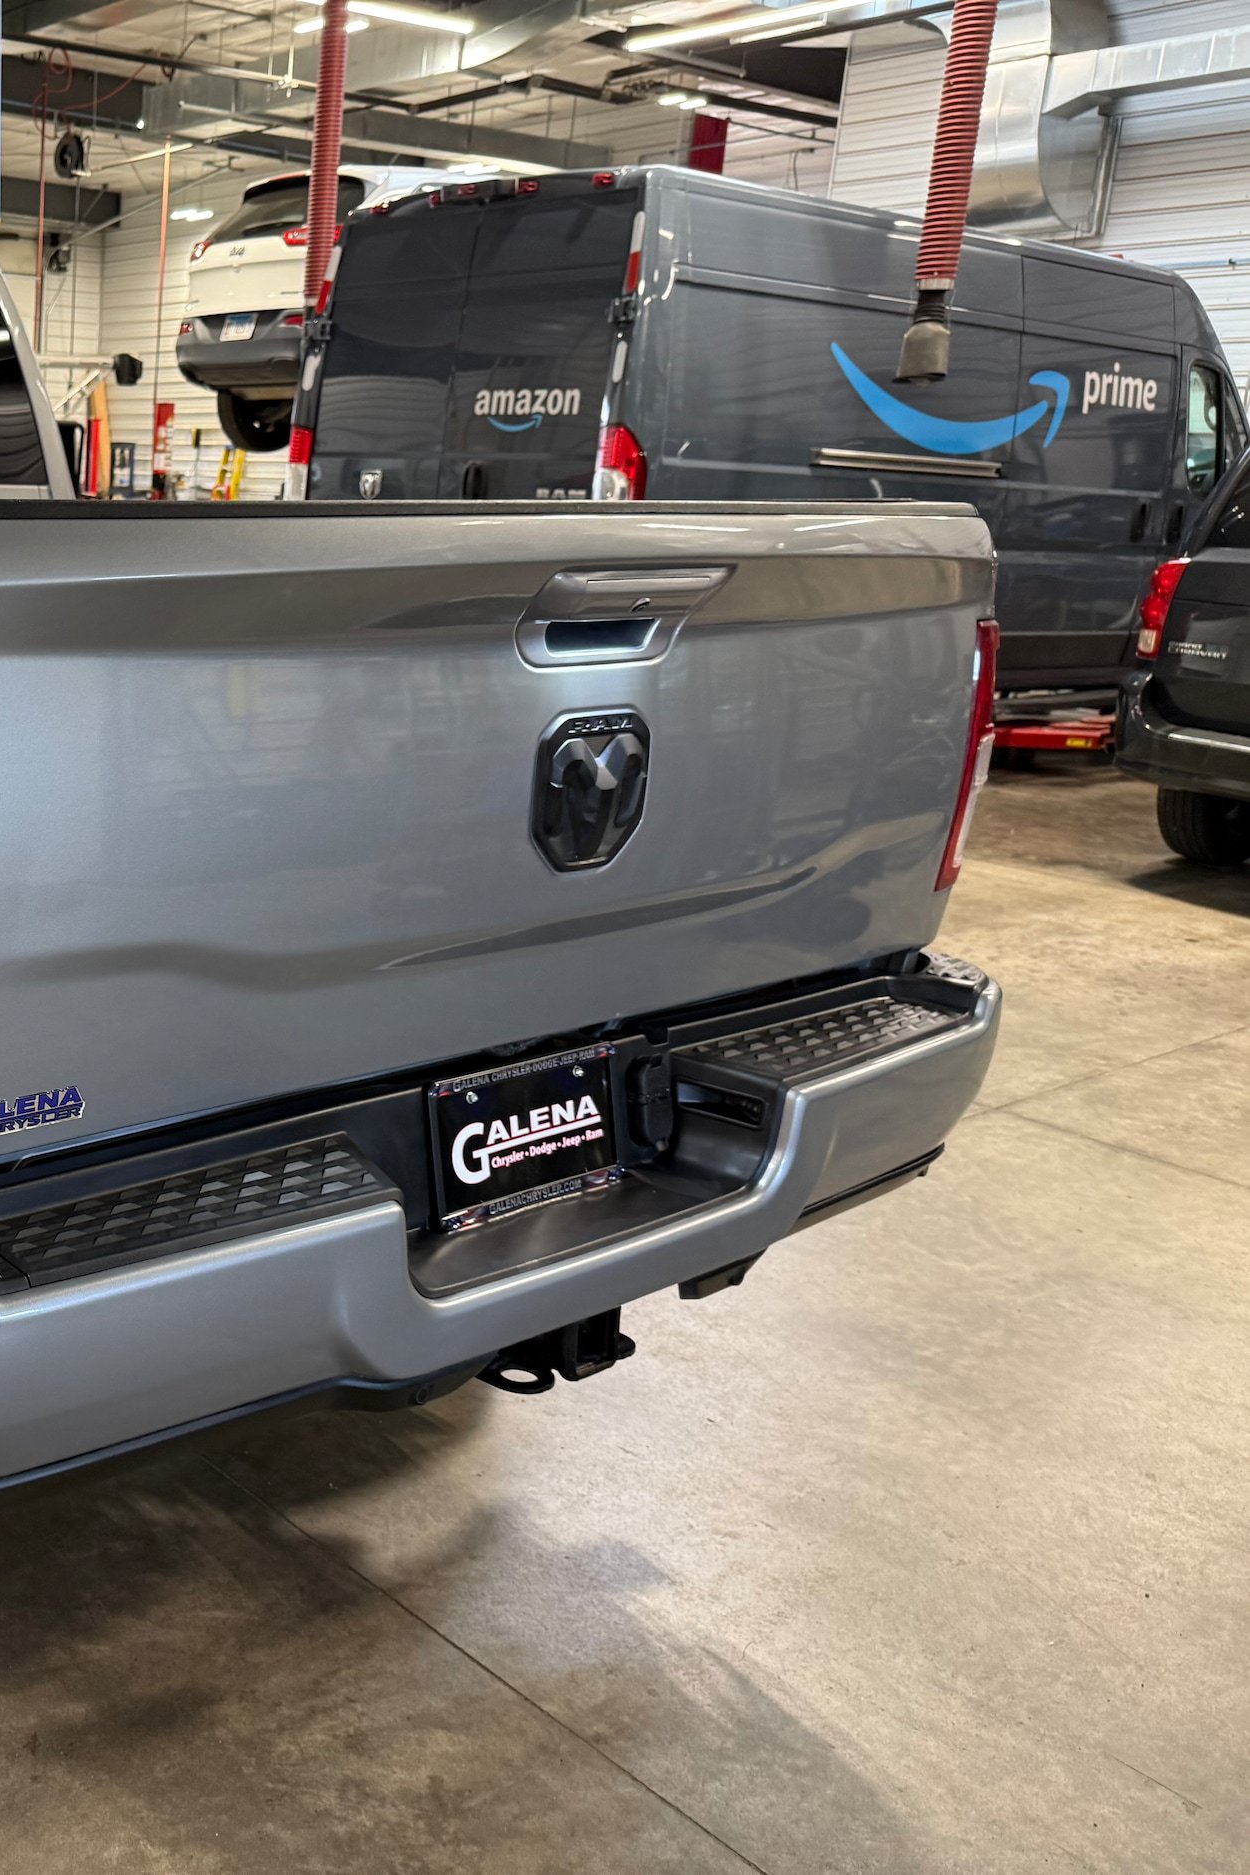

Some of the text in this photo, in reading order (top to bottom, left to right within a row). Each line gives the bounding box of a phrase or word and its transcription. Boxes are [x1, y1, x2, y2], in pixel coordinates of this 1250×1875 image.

[474, 388, 581, 416] amazon
[1082, 361, 1157, 414] prime
[452, 1095, 600, 1184] GALENA
[491, 1128, 604, 1168] Chrysler Dodge Jeep Ram
